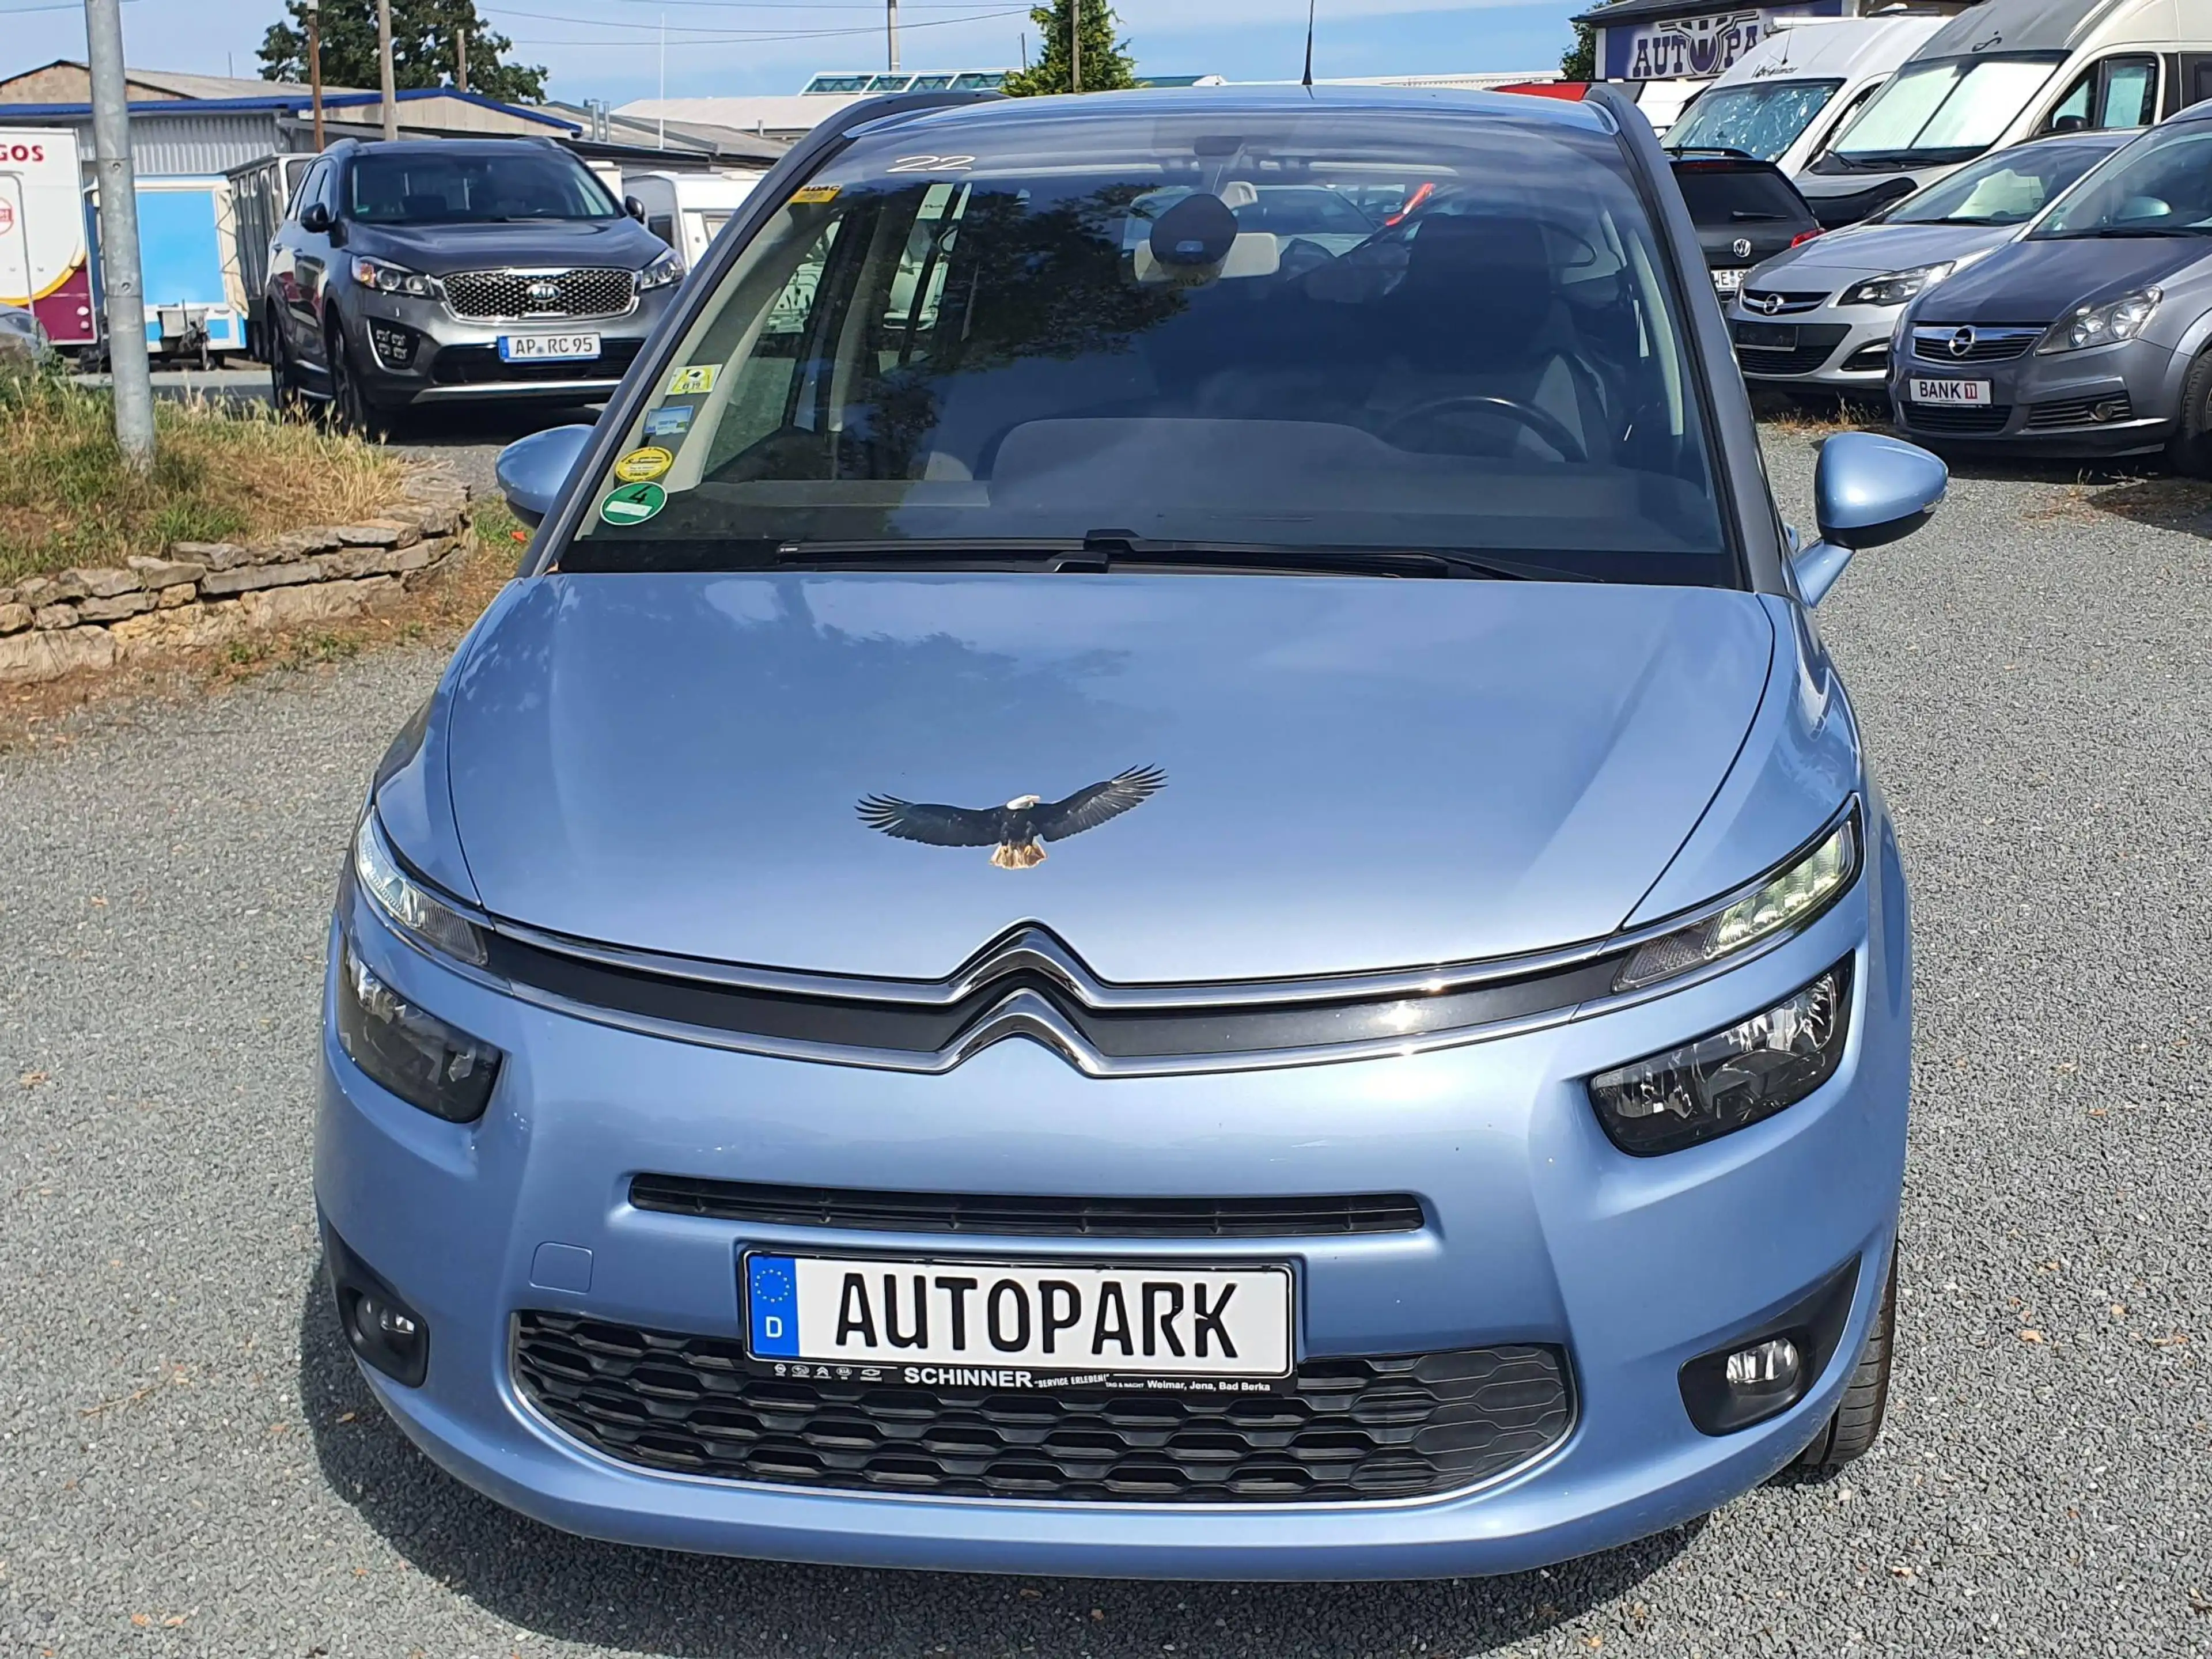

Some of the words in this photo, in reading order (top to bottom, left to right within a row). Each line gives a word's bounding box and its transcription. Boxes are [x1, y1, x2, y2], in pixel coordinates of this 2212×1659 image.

[886, 155, 976, 172] 22
[516, 339, 536, 355] AP
[548, 338, 569, 354] RC
[573, 337, 592, 353] 95
[1919, 381, 1961, 399] BANK
[628, 485, 652, 504] 4
[835, 1272, 1238, 1358] AUTOPARK
[766, 1316, 782, 1338] D
[904, 1366, 1034, 1388] SCHINNER
[1147, 1380, 1187, 1391] Weimar,
[1189, 1381, 1217, 1392] Jena,
[1219, 1381, 1239, 1391] Bad
[1241, 1382, 1271, 1391] Berka
